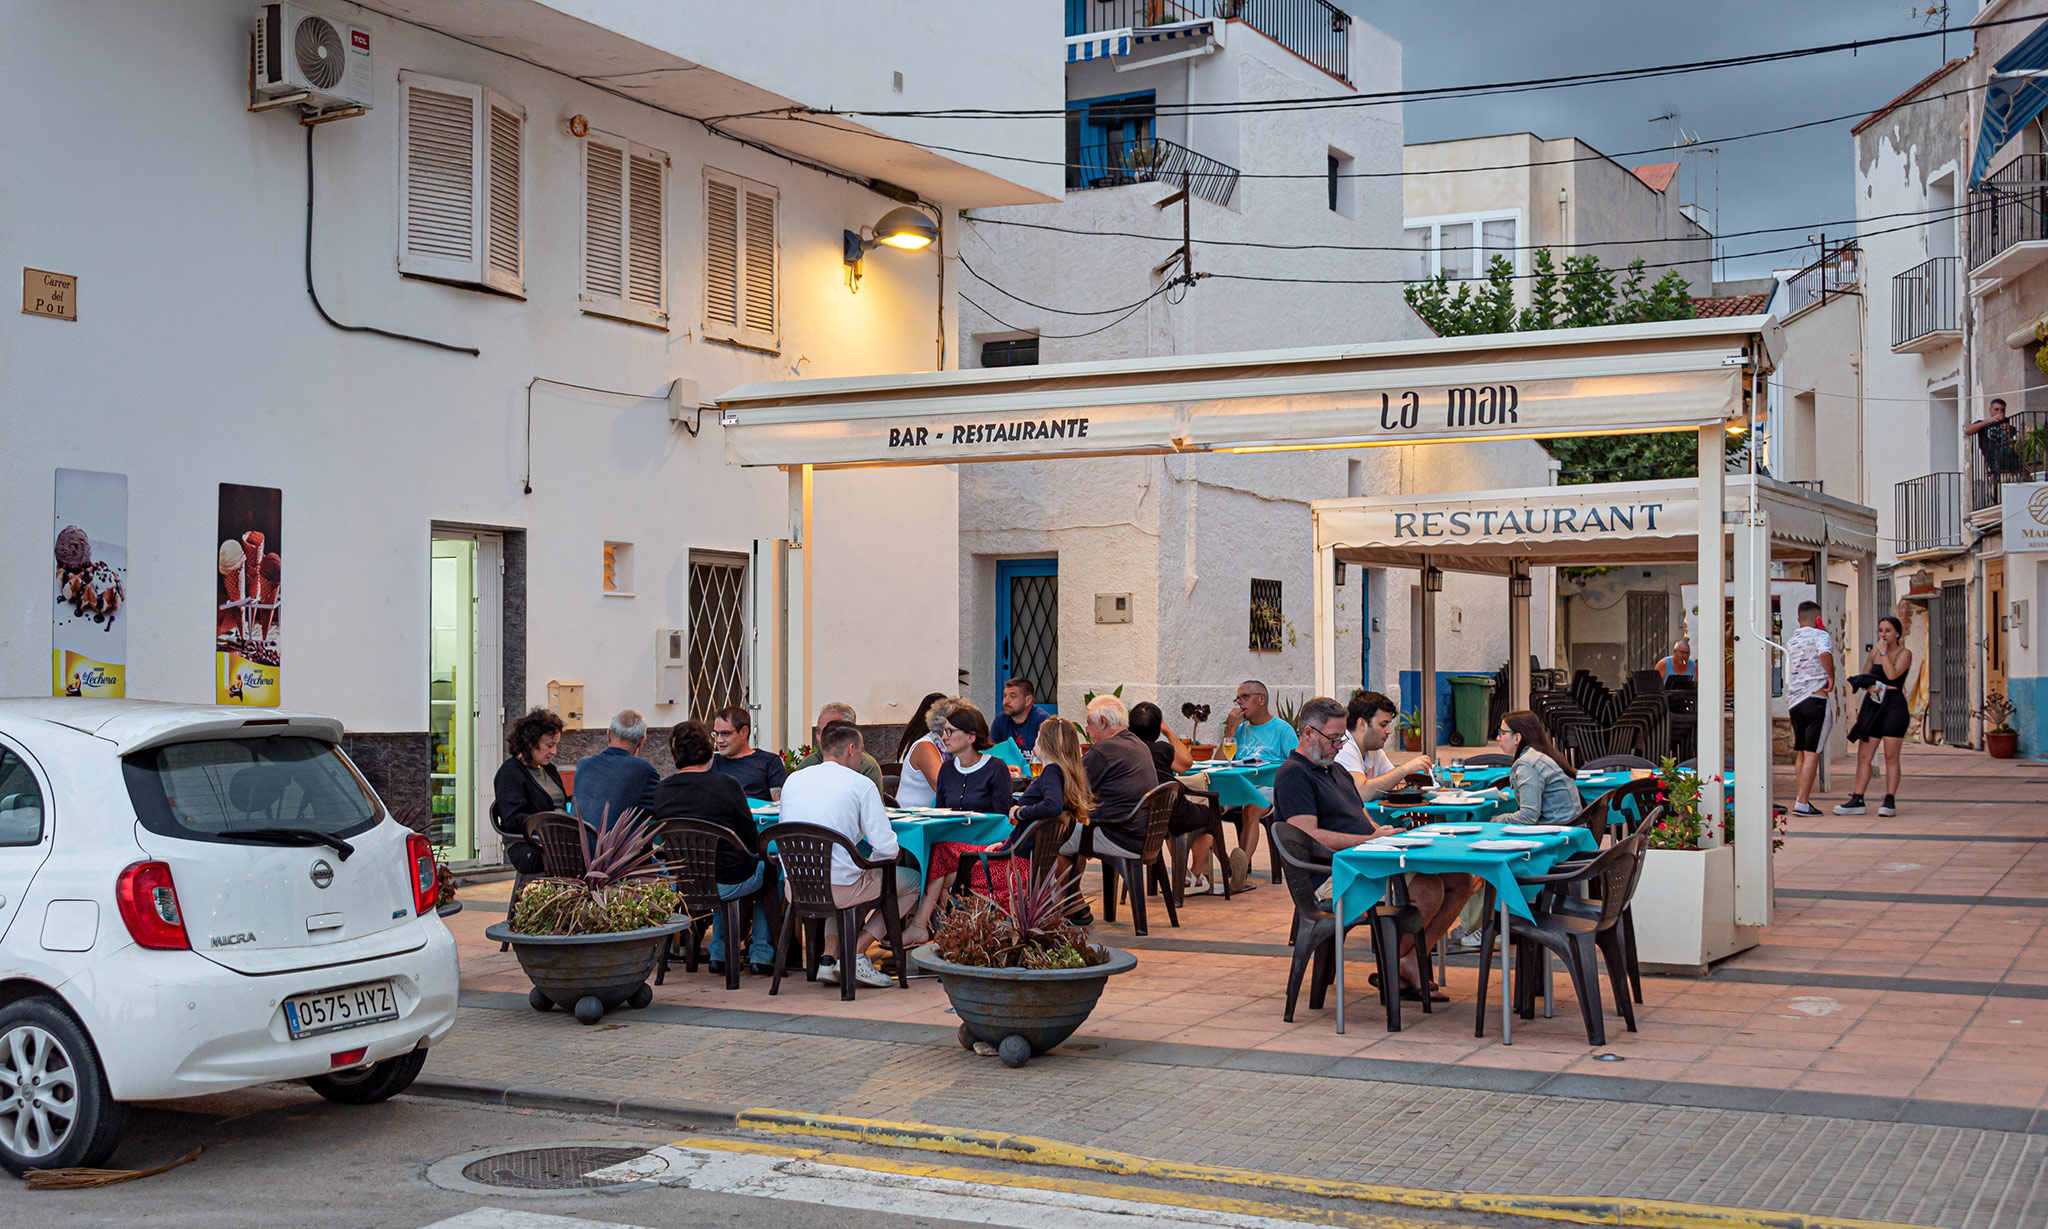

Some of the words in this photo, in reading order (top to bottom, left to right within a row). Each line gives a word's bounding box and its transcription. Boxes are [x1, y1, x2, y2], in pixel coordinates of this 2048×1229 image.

[353, 34, 368, 45] TCL
[44, 274, 71, 290] Carrer
[51, 290, 64, 302] del
[35, 298, 65, 314] Pou
[888, 426, 929, 448] BAR
[951, 417, 1090, 445] RESTAURANTE
[1394, 503, 1664, 539] RESTAURANT
[85, 671, 117, 686] Lechera
[247, 672, 274, 686] Lechera
[210, 931, 257, 948] MICRA
[299, 994, 352, 1027] 0575
[354, 987, 392, 1016] HYZ
